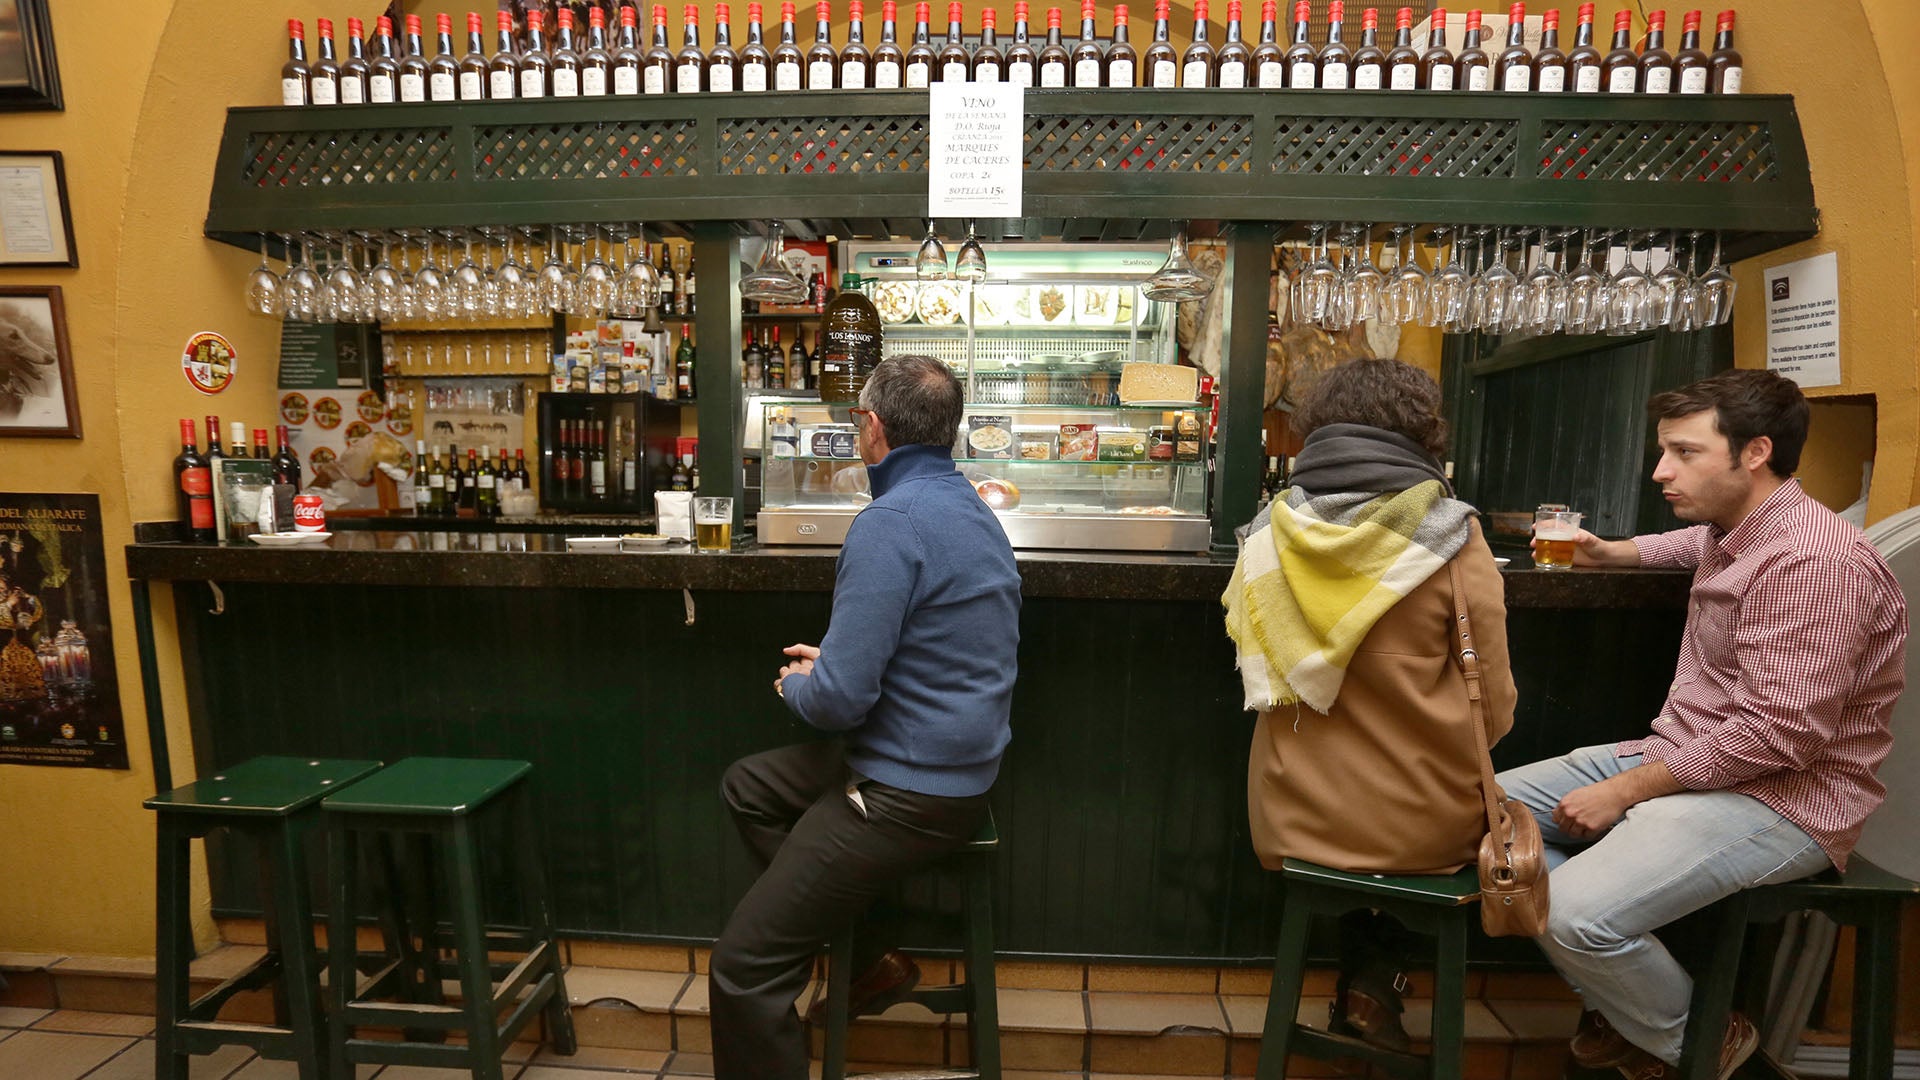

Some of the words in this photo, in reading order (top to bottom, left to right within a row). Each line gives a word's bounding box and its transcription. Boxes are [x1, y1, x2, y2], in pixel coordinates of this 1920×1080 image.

[962, 96, 996, 108] VINO
[977, 122, 1001, 133] Rioja
[945, 143, 999, 154] MARQUES
[945, 156, 960, 164] DE
[962, 156, 1010, 165] CACERES
[950, 171, 974, 179] COPA
[949, 187, 988, 195] BOTELLA
[26, 508, 87, 520] ALJARAFE
